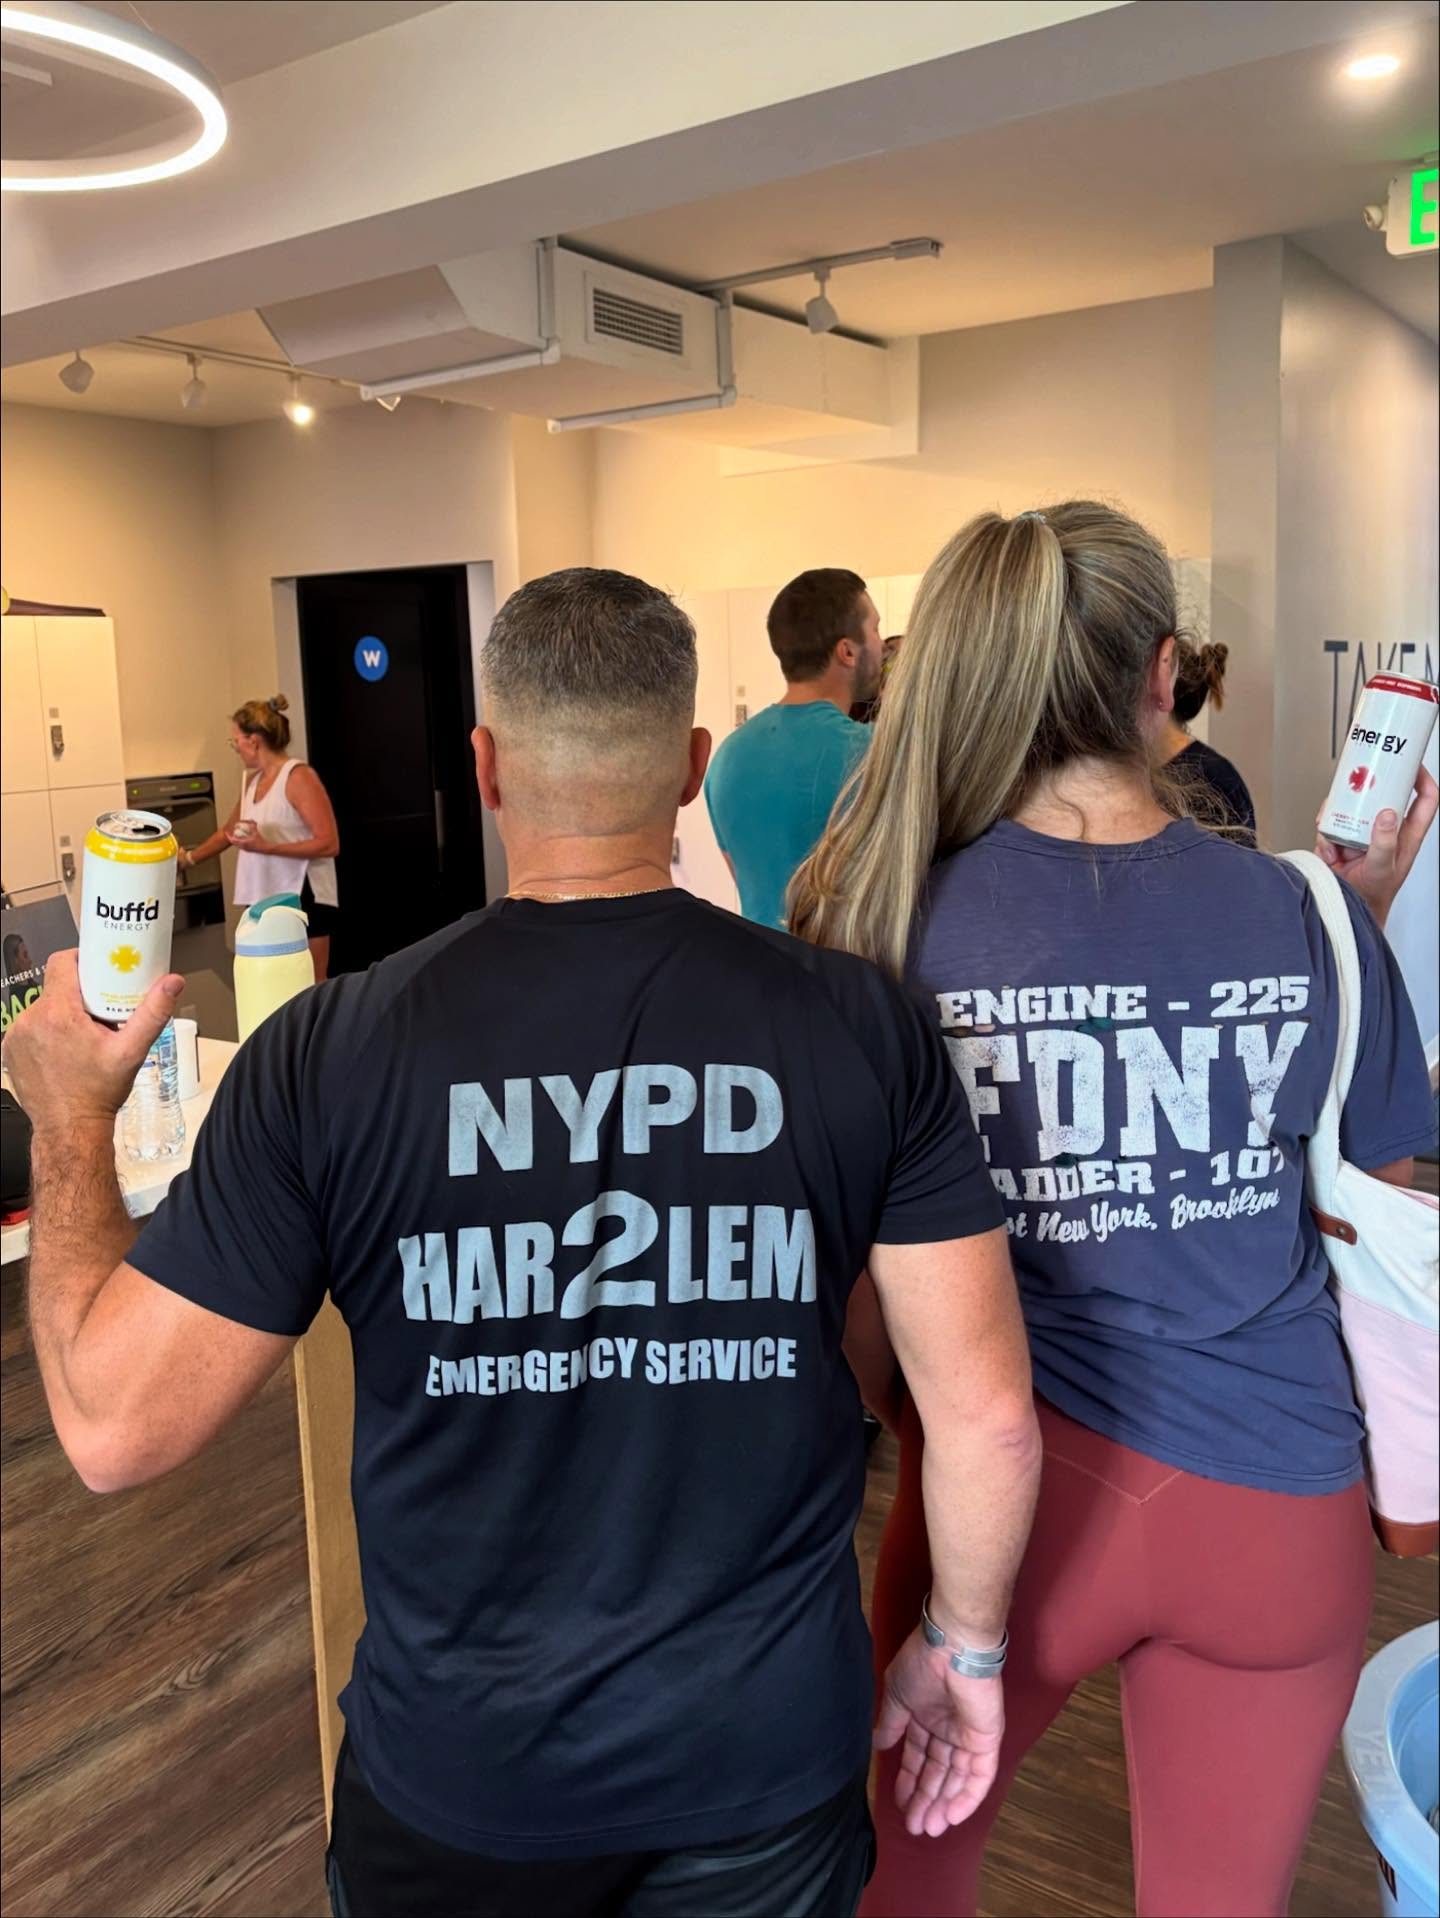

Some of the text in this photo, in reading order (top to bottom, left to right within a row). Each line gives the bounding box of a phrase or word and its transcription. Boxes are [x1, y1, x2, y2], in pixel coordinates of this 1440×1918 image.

[362, 650, 381, 668] W
[104, 920, 151, 931] ENERGY
[936, 985, 1148, 1029] ENGINE
[1210, 976, 1310, 1018] 225
[942, 1021, 1310, 1163] FDNY
[449, 1064, 783, 1176] NYPD
[989, 1161, 1155, 1201] ADDER
[1037, 1211, 1089, 1244] New
[1170, 1186, 1281, 1230] Brooklyn
[426, 1337, 797, 1397] EMERGENCY SERVICE
